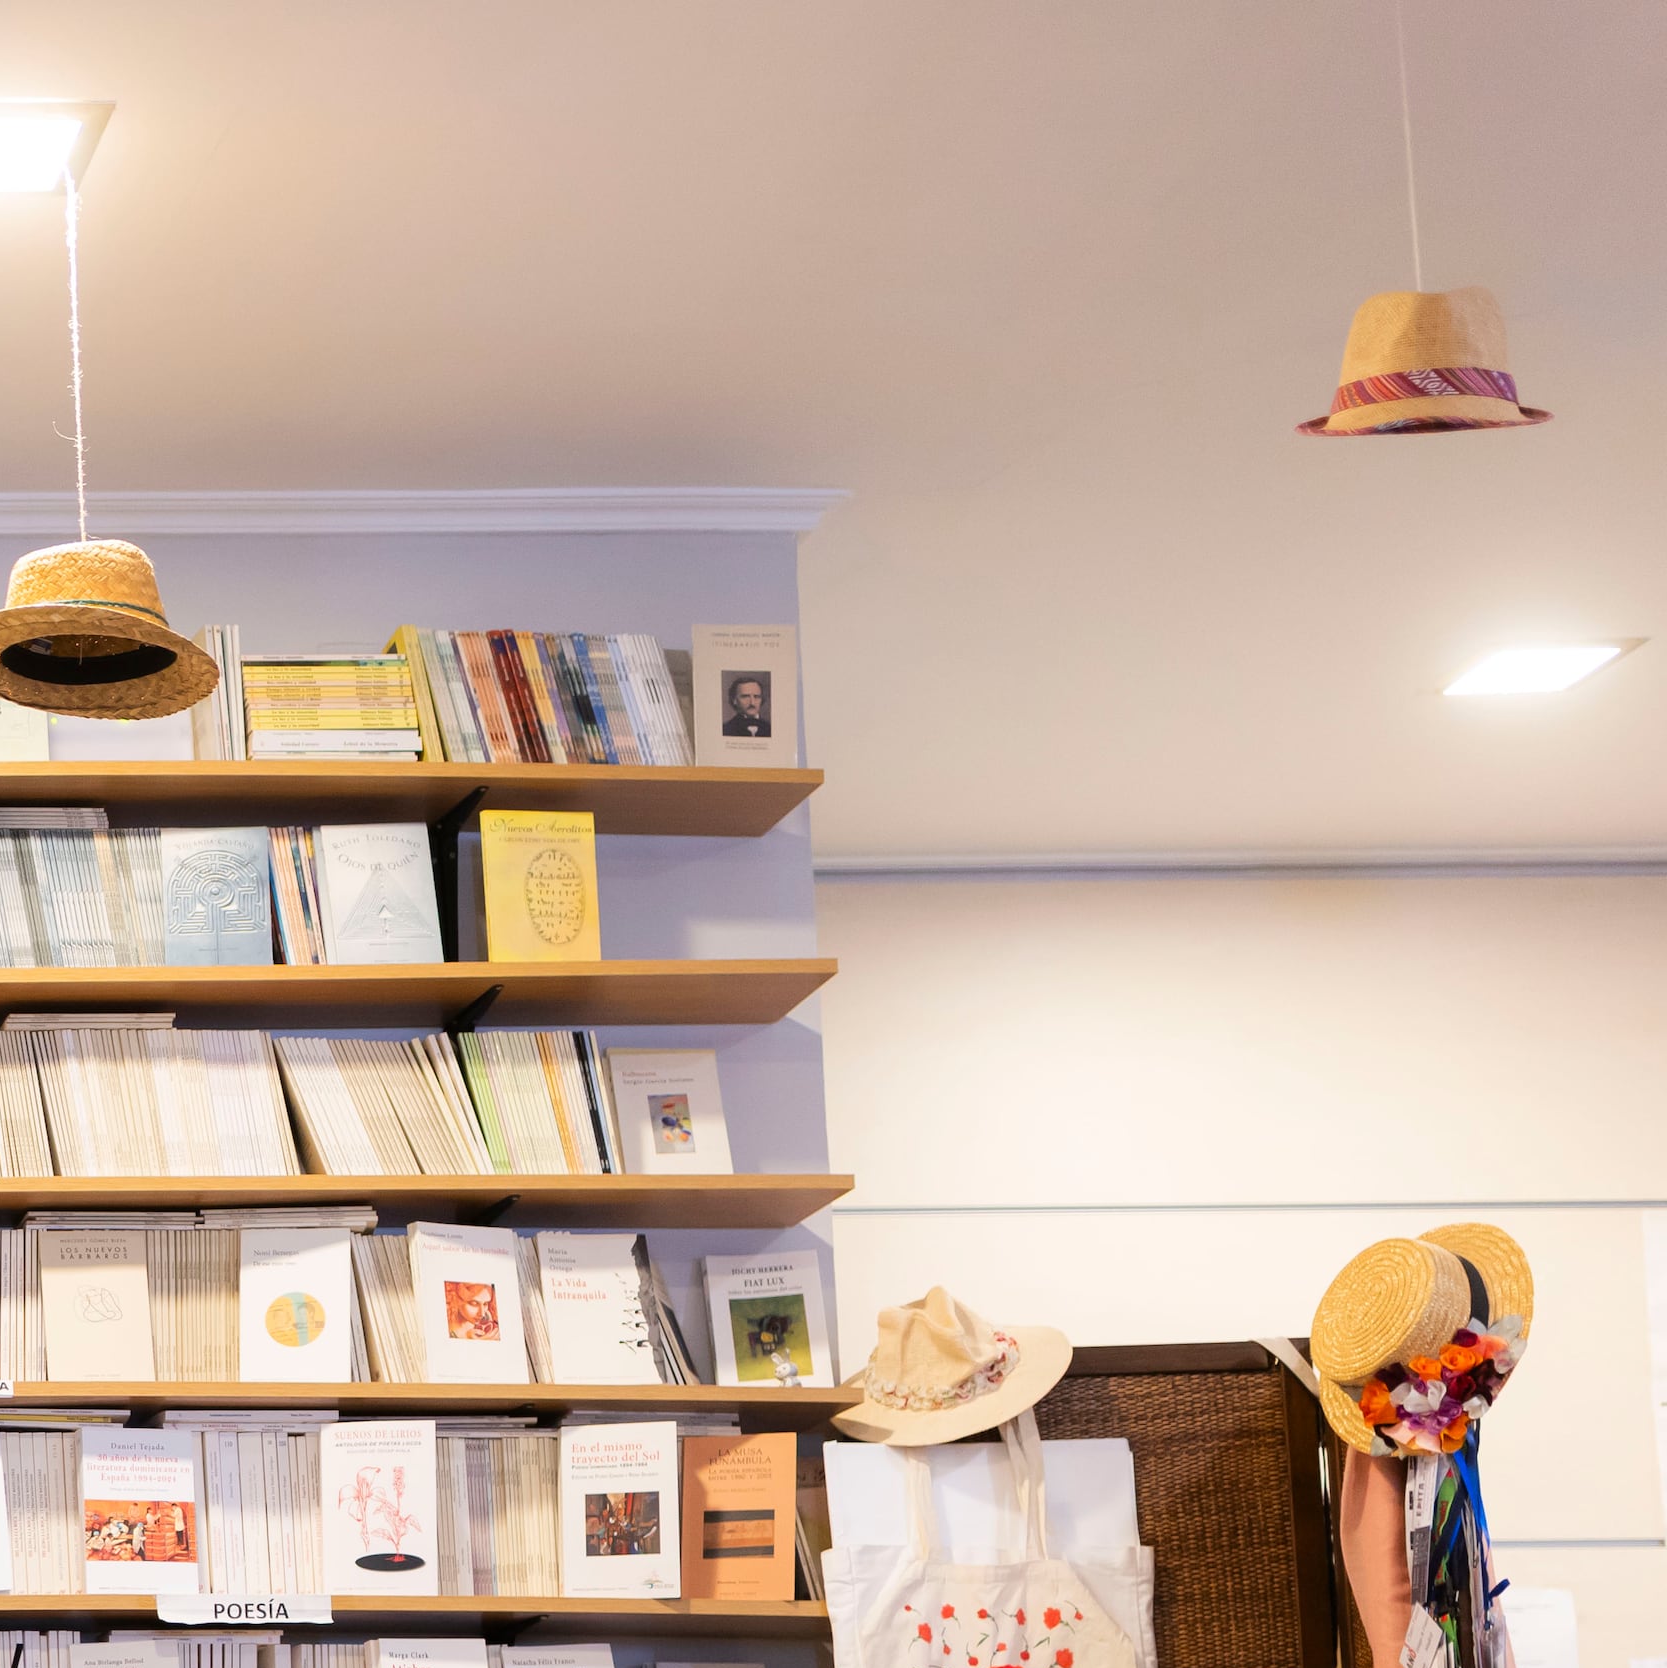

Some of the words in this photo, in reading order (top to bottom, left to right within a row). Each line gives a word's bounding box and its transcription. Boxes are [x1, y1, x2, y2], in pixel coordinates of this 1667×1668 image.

[332, 836, 359, 850] RUTH
[365, 833, 421, 849] TOLEDANO
[59, 1245, 78, 1253] LOS
[85, 1245, 128, 1253] NUEVOS
[59, 1252, 128, 1260] BÁRBAROS
[551, 1278, 563, 1288] La
[564, 1278, 587, 1288] Vida
[553, 1290, 607, 1303] Intranquila
[111, 1442, 136, 1451] Daniel
[138, 1442, 165, 1452] Tejada
[571, 1443, 586, 1453] En
[590, 1443, 602, 1453] el
[603, 1442, 643, 1452] mismo
[571, 1453, 619, 1466] trayecto
[621, 1451, 639, 1462] del
[642, 1450, 660, 1461] Sol
[213, 1598, 290, 1619] POESÍA
